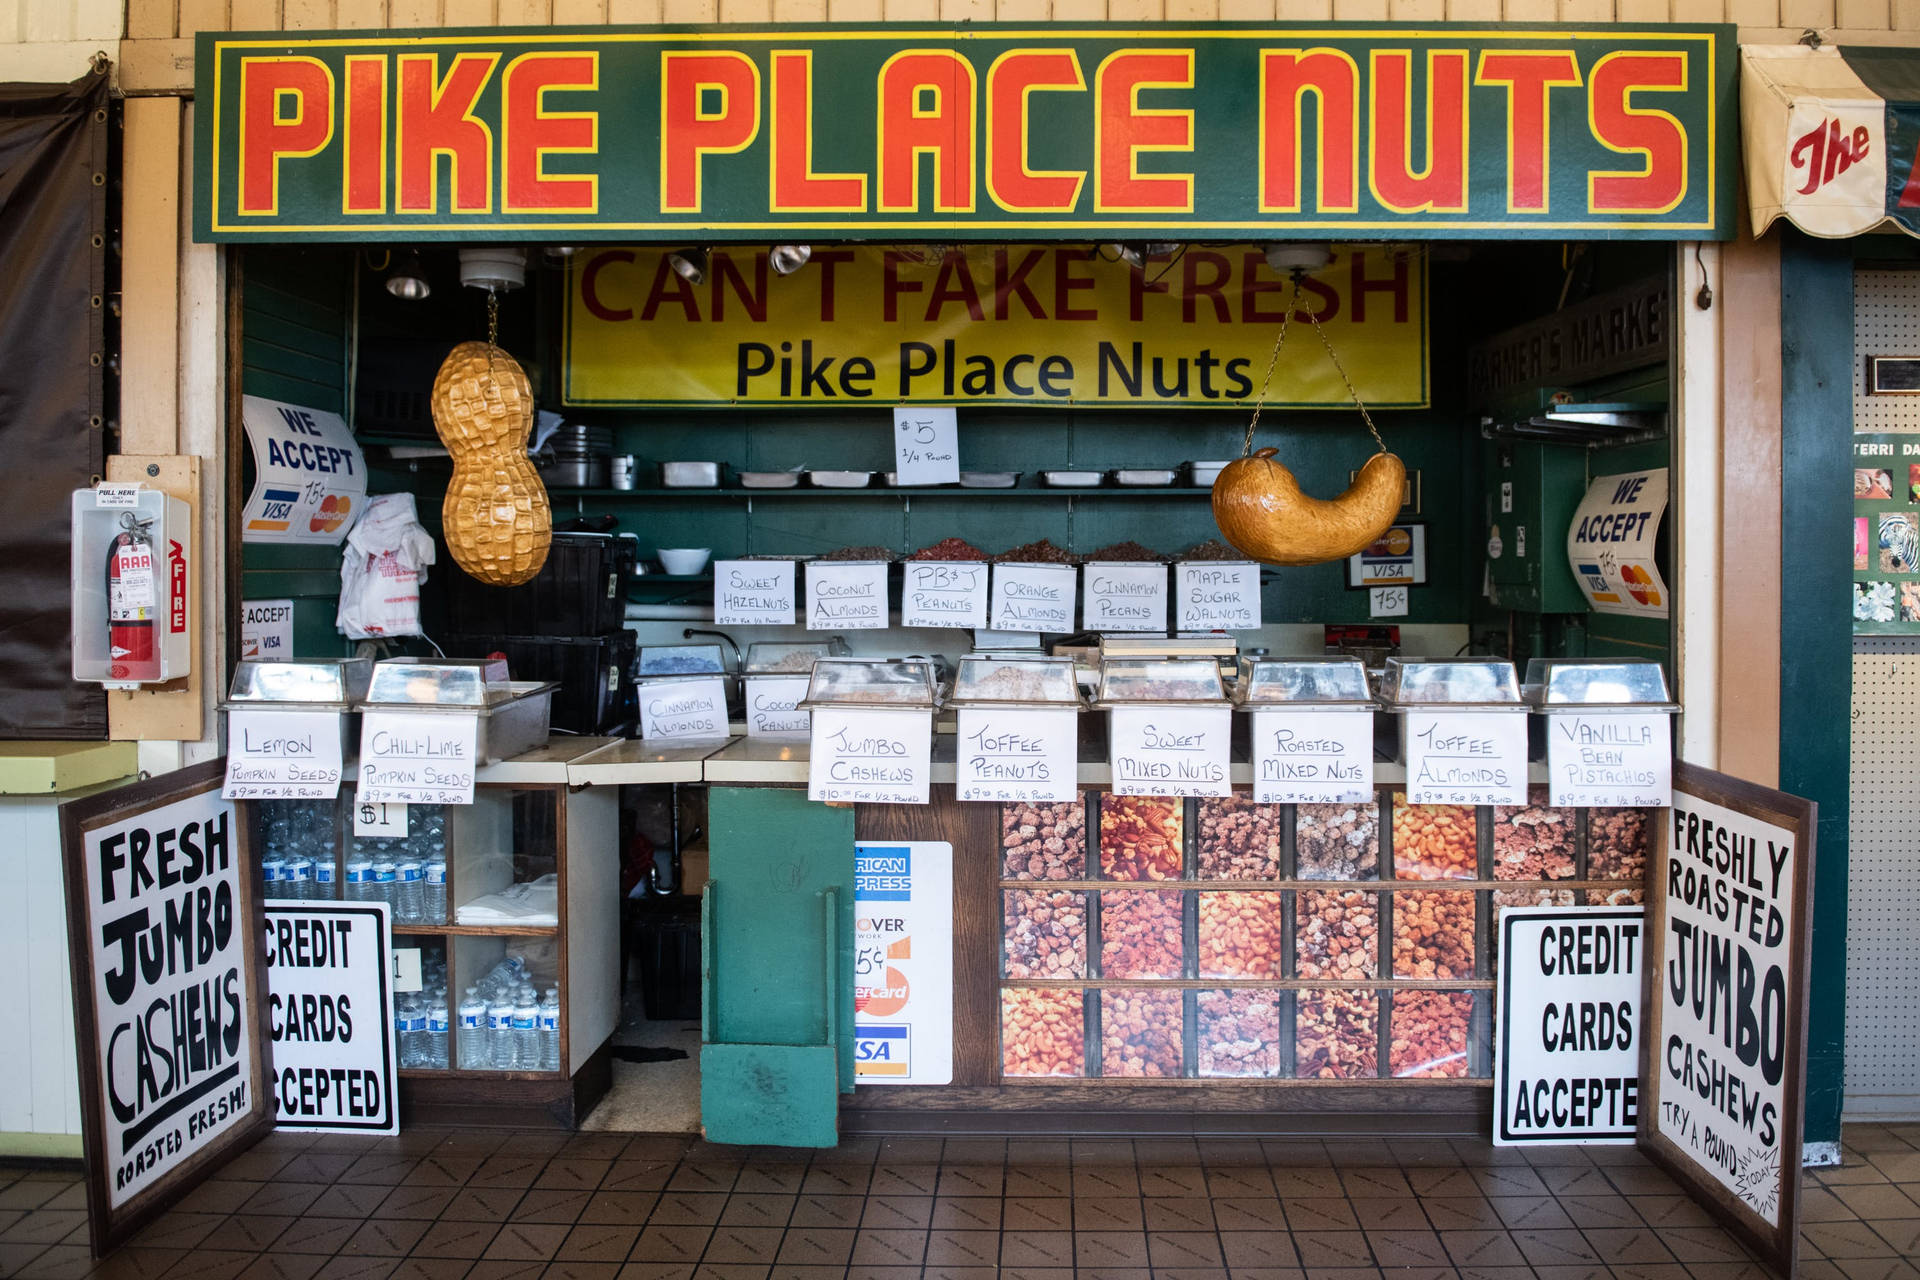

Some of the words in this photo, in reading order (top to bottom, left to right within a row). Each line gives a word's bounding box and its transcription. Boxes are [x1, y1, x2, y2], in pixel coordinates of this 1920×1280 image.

[238, 51, 600, 216] PIKE
[660, 48, 1195, 214] PLACE
[1258, 47, 1690, 214] NUTS
[1790, 117, 1870, 195] The
[580, 250, 855, 323] CANT
[883, 249, 1099, 322] FAKE
[1129, 249, 1409, 324] FRESH
[1571, 288, 1668, 366] MARKE
[737, 339, 876, 398] Pike
[900, 338, 1075, 398] Place
[1098, 341, 1254, 399] Nuts
[277, 407, 322, 437] WE
[268, 438, 354, 476] ACCEPT
[902, 448, 920, 464] 1/4
[1611, 477, 1648, 505] WE
[262, 502, 292, 519] VISA
[1576, 512, 1652, 543] ACCEPT
[121, 555, 150, 569] AAA
[1373, 565, 1404, 577] VISA
[730, 570, 780, 588] SWEET
[815, 580, 874, 596] COCONUT
[1003, 581, 1060, 598] ORANGE
[1186, 569, 1241, 586] MAPLE
[1587, 576, 1610, 592] VISA
[174, 564, 184, 627] FIRE
[724, 591, 790, 610] HAZELNUTS
[912, 593, 973, 610] PEANUTS
[1191, 587, 1241, 604] SUGAR
[247, 607, 290, 624] ACCEPT
[815, 600, 878, 618] ALMONDS
[1000, 601, 1067, 619] ALMONDS
[1096, 598, 1152, 618] PECANS
[1185, 606, 1252, 621] WALNUTS
[263, 636, 281, 648] VISA
[649, 698, 714, 717] CINNAMON
[650, 719, 714, 736] ALMONDS
[967, 724, 1044, 752] TOFFEE
[1143, 724, 1206, 748] SWEET
[1417, 722, 1495, 754] TOFFEE
[1560, 718, 1652, 744] VANILLA
[245, 728, 312, 756] LEMON
[825, 727, 906, 755] JUMBO
[1273, 729, 1345, 753] ROASTED
[1579, 748, 1623, 763] BEAN
[231, 763, 277, 782] PUMPKIN
[288, 763, 338, 782] SEEDS
[364, 764, 416, 786] PUMPKIN
[424, 766, 472, 788] SEEDS
[830, 761, 914, 783] CASHEWS
[970, 757, 1050, 780] PEANUTS
[1117, 757, 1171, 780] MIXED
[1178, 758, 1224, 781] NUTS
[1263, 759, 1318, 779] MIXED
[1327, 760, 1364, 780] NUTS
[1417, 756, 1508, 785] ALMONDS
[1563, 764, 1656, 785] PISTACHIOS
[360, 803, 390, 826] $1
[99, 810, 229, 904] FRESH
[856, 857, 906, 872] RICAN
[1673, 808, 1789, 900] FRESHLY
[856, 876, 912, 891] PRESS
[1668, 858, 1784, 949] ROASTED
[857, 918, 904, 932] OVER
[102, 879, 232, 1005] JUMBO
[264, 918, 352, 968] CREDIT
[1539, 925, 1639, 977] CREDIT
[1668, 917, 1786, 1087] JUMBO
[269, 993, 351, 1043] CARDS
[1542, 1001, 1633, 1053] CARDS
[107, 967, 241, 1124] CASHEWS
[1513, 1077, 1638, 1128] ACCEPTE
[1667, 1034, 1777, 1148] CASHEWS
[117, 1132, 183, 1191] ROASTED
[188, 1081, 246, 1141] FRESH!
[1662, 1101, 1689, 1139] TRY
[1690, 1119, 1699, 1151] A
[1704, 1124, 1738, 1177] POUND
[1745, 1163, 1772, 1188] TODAY
